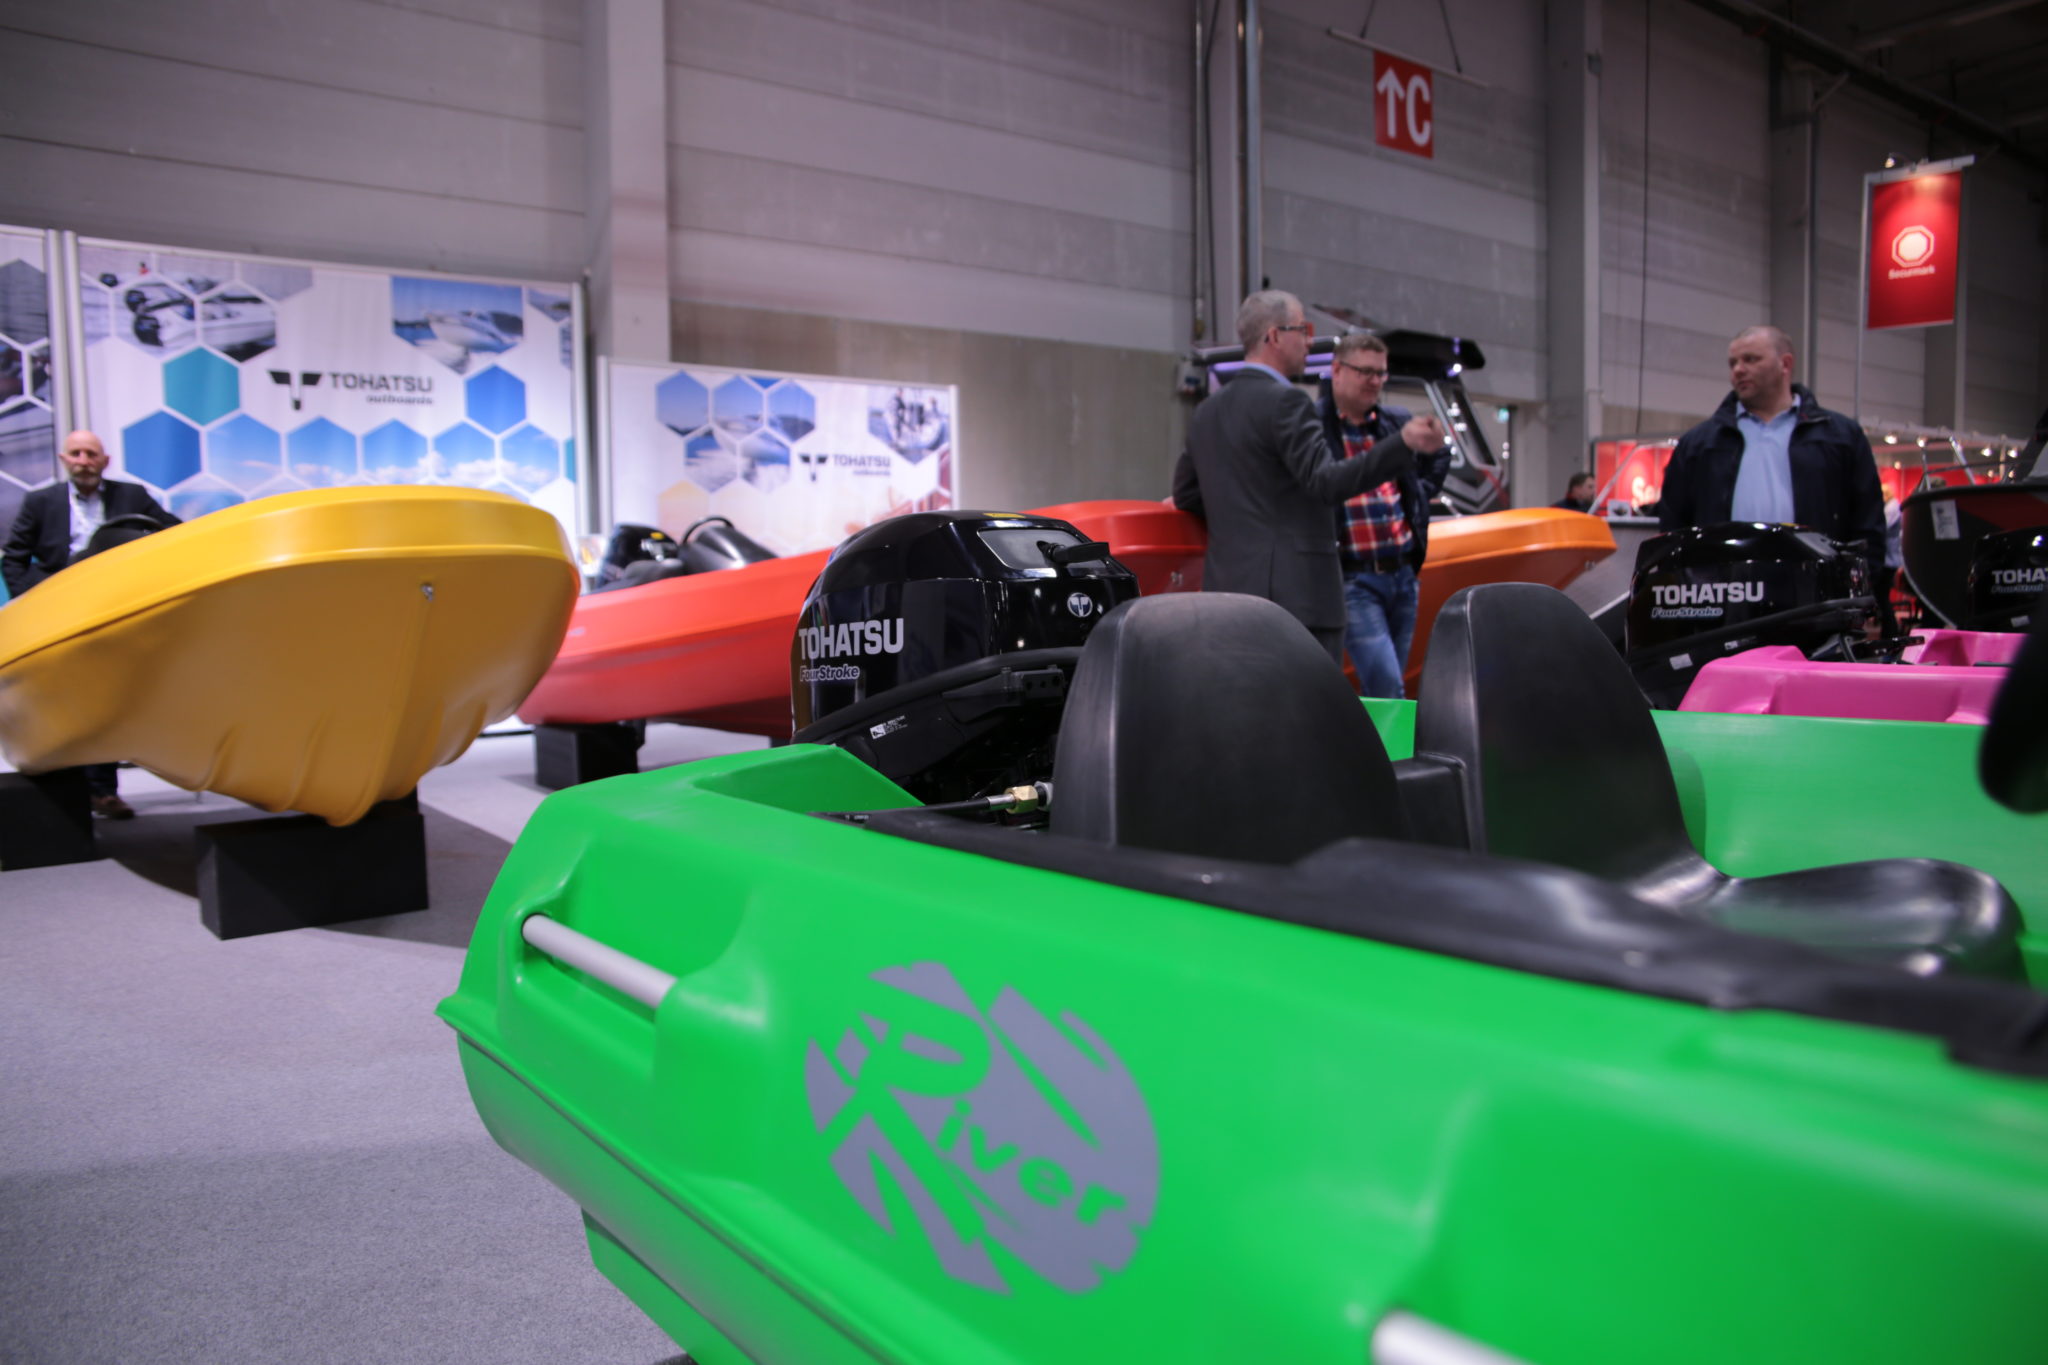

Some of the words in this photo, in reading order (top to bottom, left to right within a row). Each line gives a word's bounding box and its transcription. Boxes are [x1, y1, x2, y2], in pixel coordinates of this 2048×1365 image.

[1406, 75, 1430, 146] C
[331, 371, 433, 393] TOHATSU
[833, 454, 891, 467] TOHATSU
[1651, 581, 1765, 606] TOHATSU
[798, 618, 905, 660] TOHATSU
[799, 663, 861, 682] FourStroke
